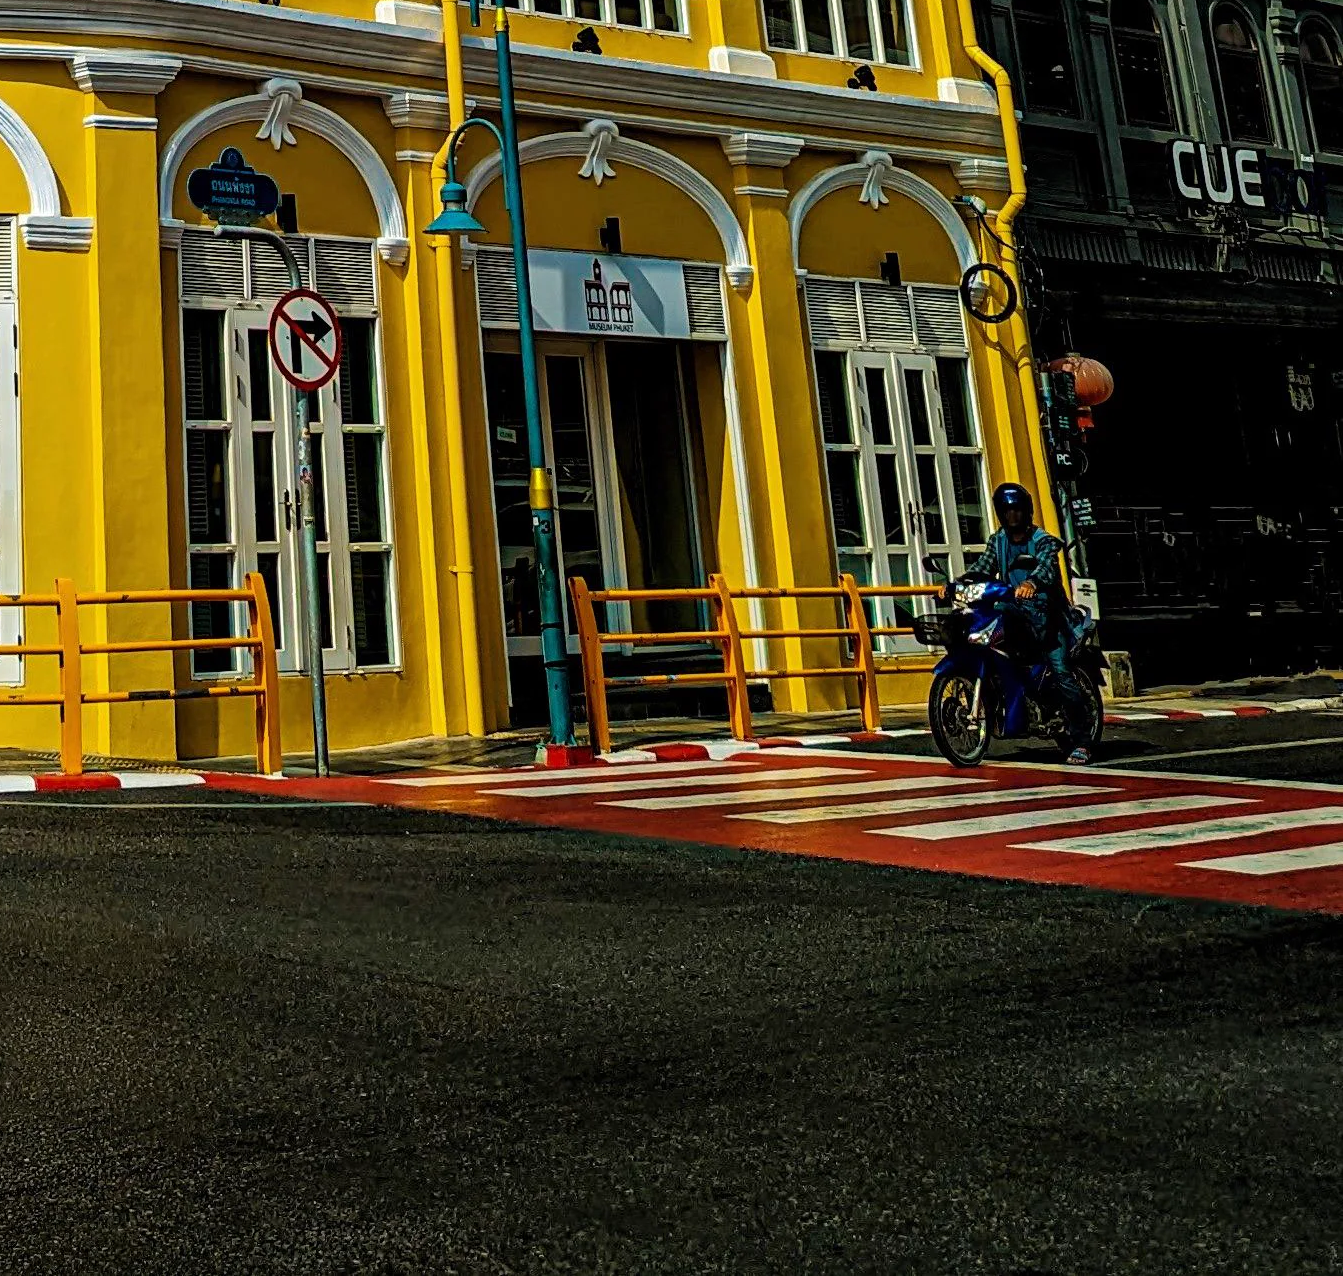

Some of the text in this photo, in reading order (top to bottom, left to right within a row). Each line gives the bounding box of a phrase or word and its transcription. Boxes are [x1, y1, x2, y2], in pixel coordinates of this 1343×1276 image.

[1172, 140, 1266, 208] CUE
[588, 322, 634, 332] MUSEUM PHUKET
